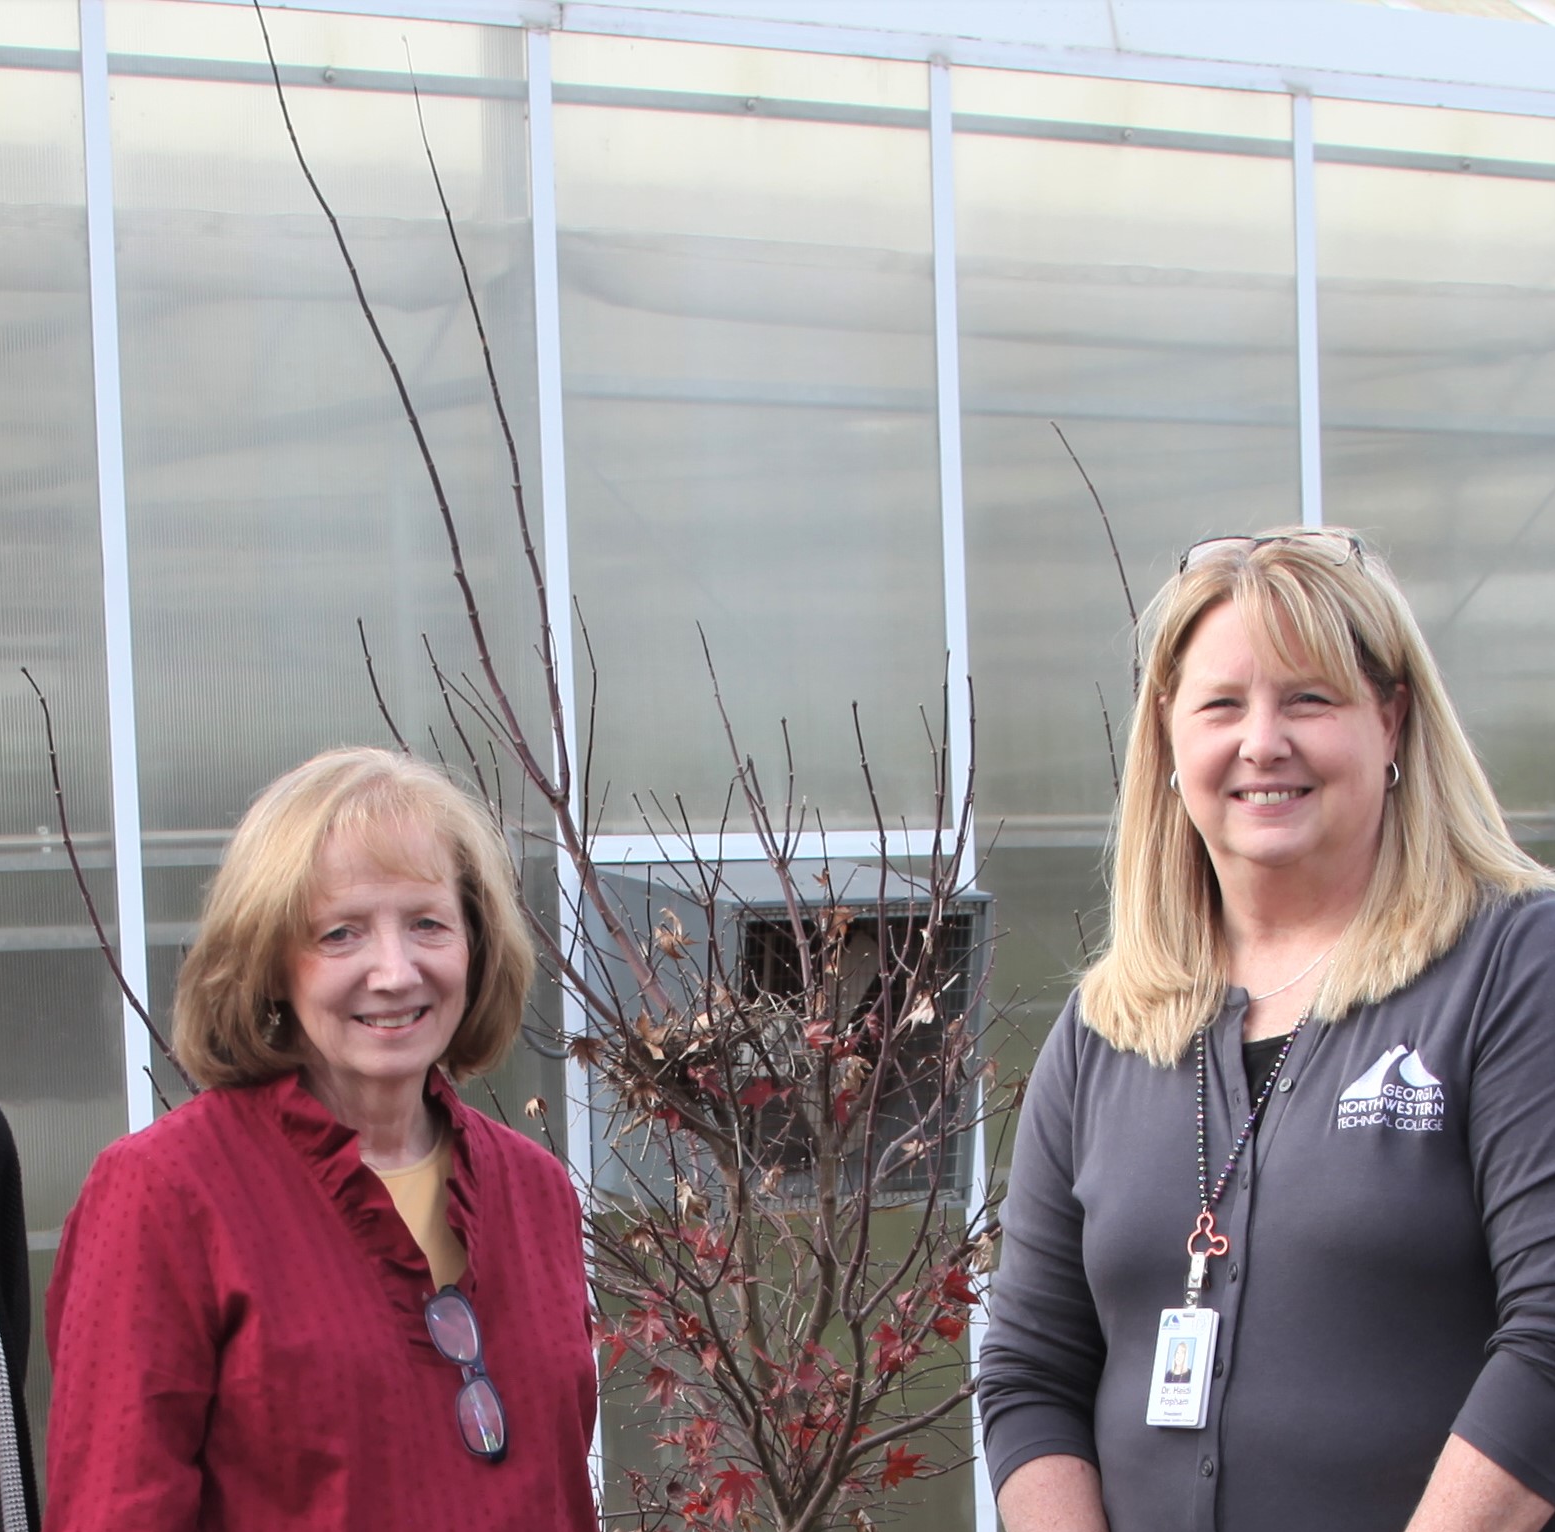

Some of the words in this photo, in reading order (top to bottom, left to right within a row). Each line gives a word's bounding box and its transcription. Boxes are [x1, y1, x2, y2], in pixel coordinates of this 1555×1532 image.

[1383, 1084, 1444, 1101] GEORGIA
[1338, 1097, 1444, 1116] NORTHWESTERN
[1395, 1118, 1443, 1131] COLLEGE
